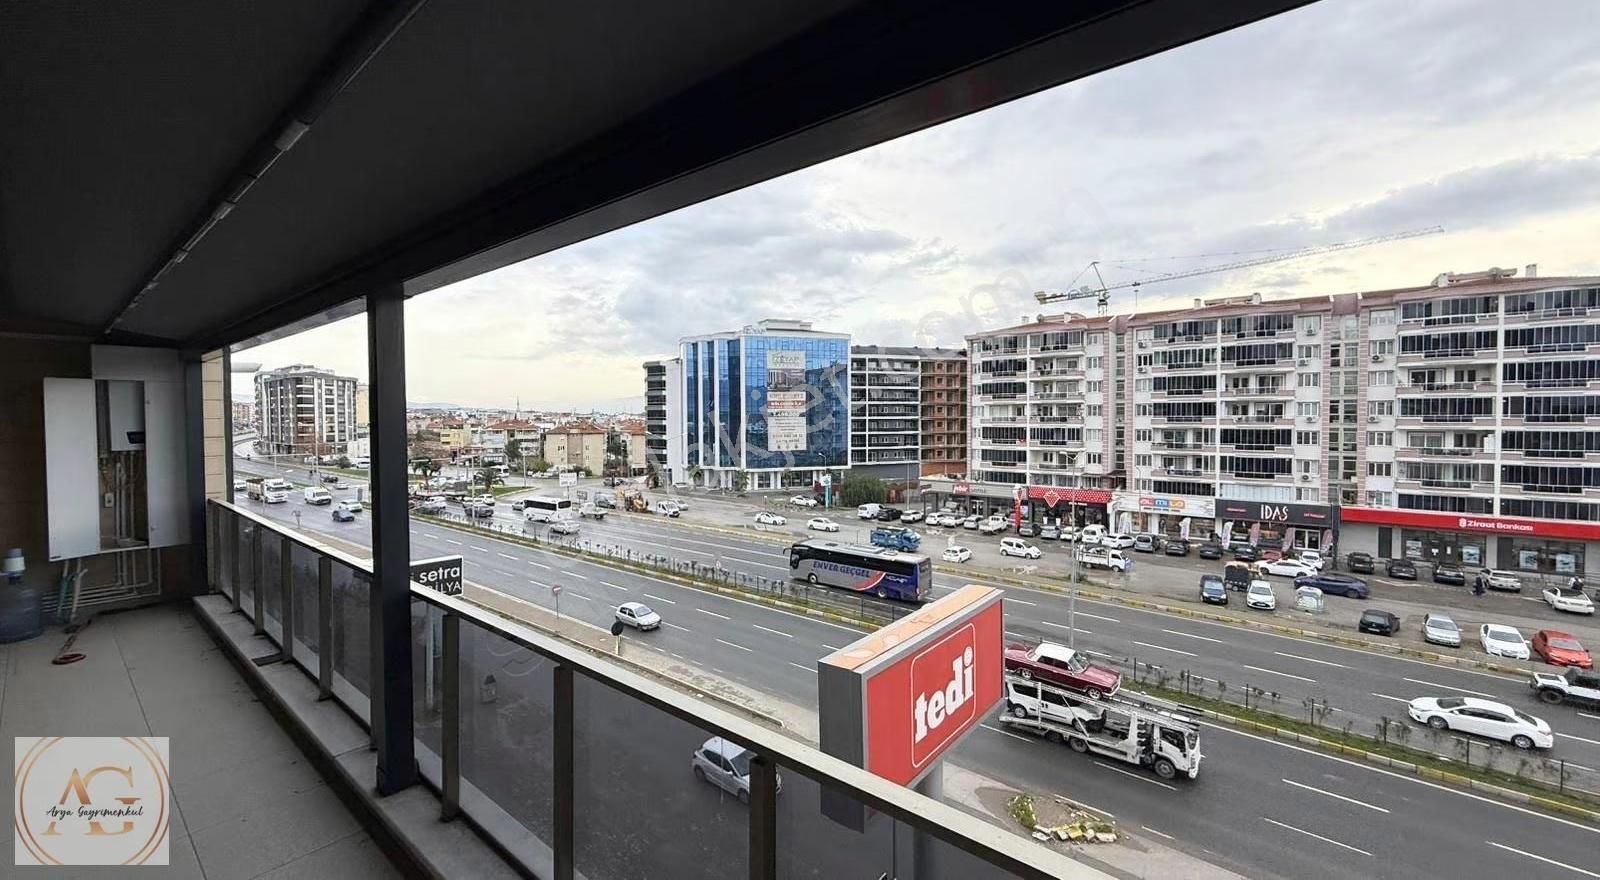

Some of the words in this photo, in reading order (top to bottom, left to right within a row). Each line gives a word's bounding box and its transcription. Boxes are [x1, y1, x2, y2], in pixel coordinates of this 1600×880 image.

[1467, 520, 1495, 529] Ziraat
[813, 561, 839, 572] ENVER
[419, 567, 460, 583] setra
[914, 646, 974, 744] tedi
